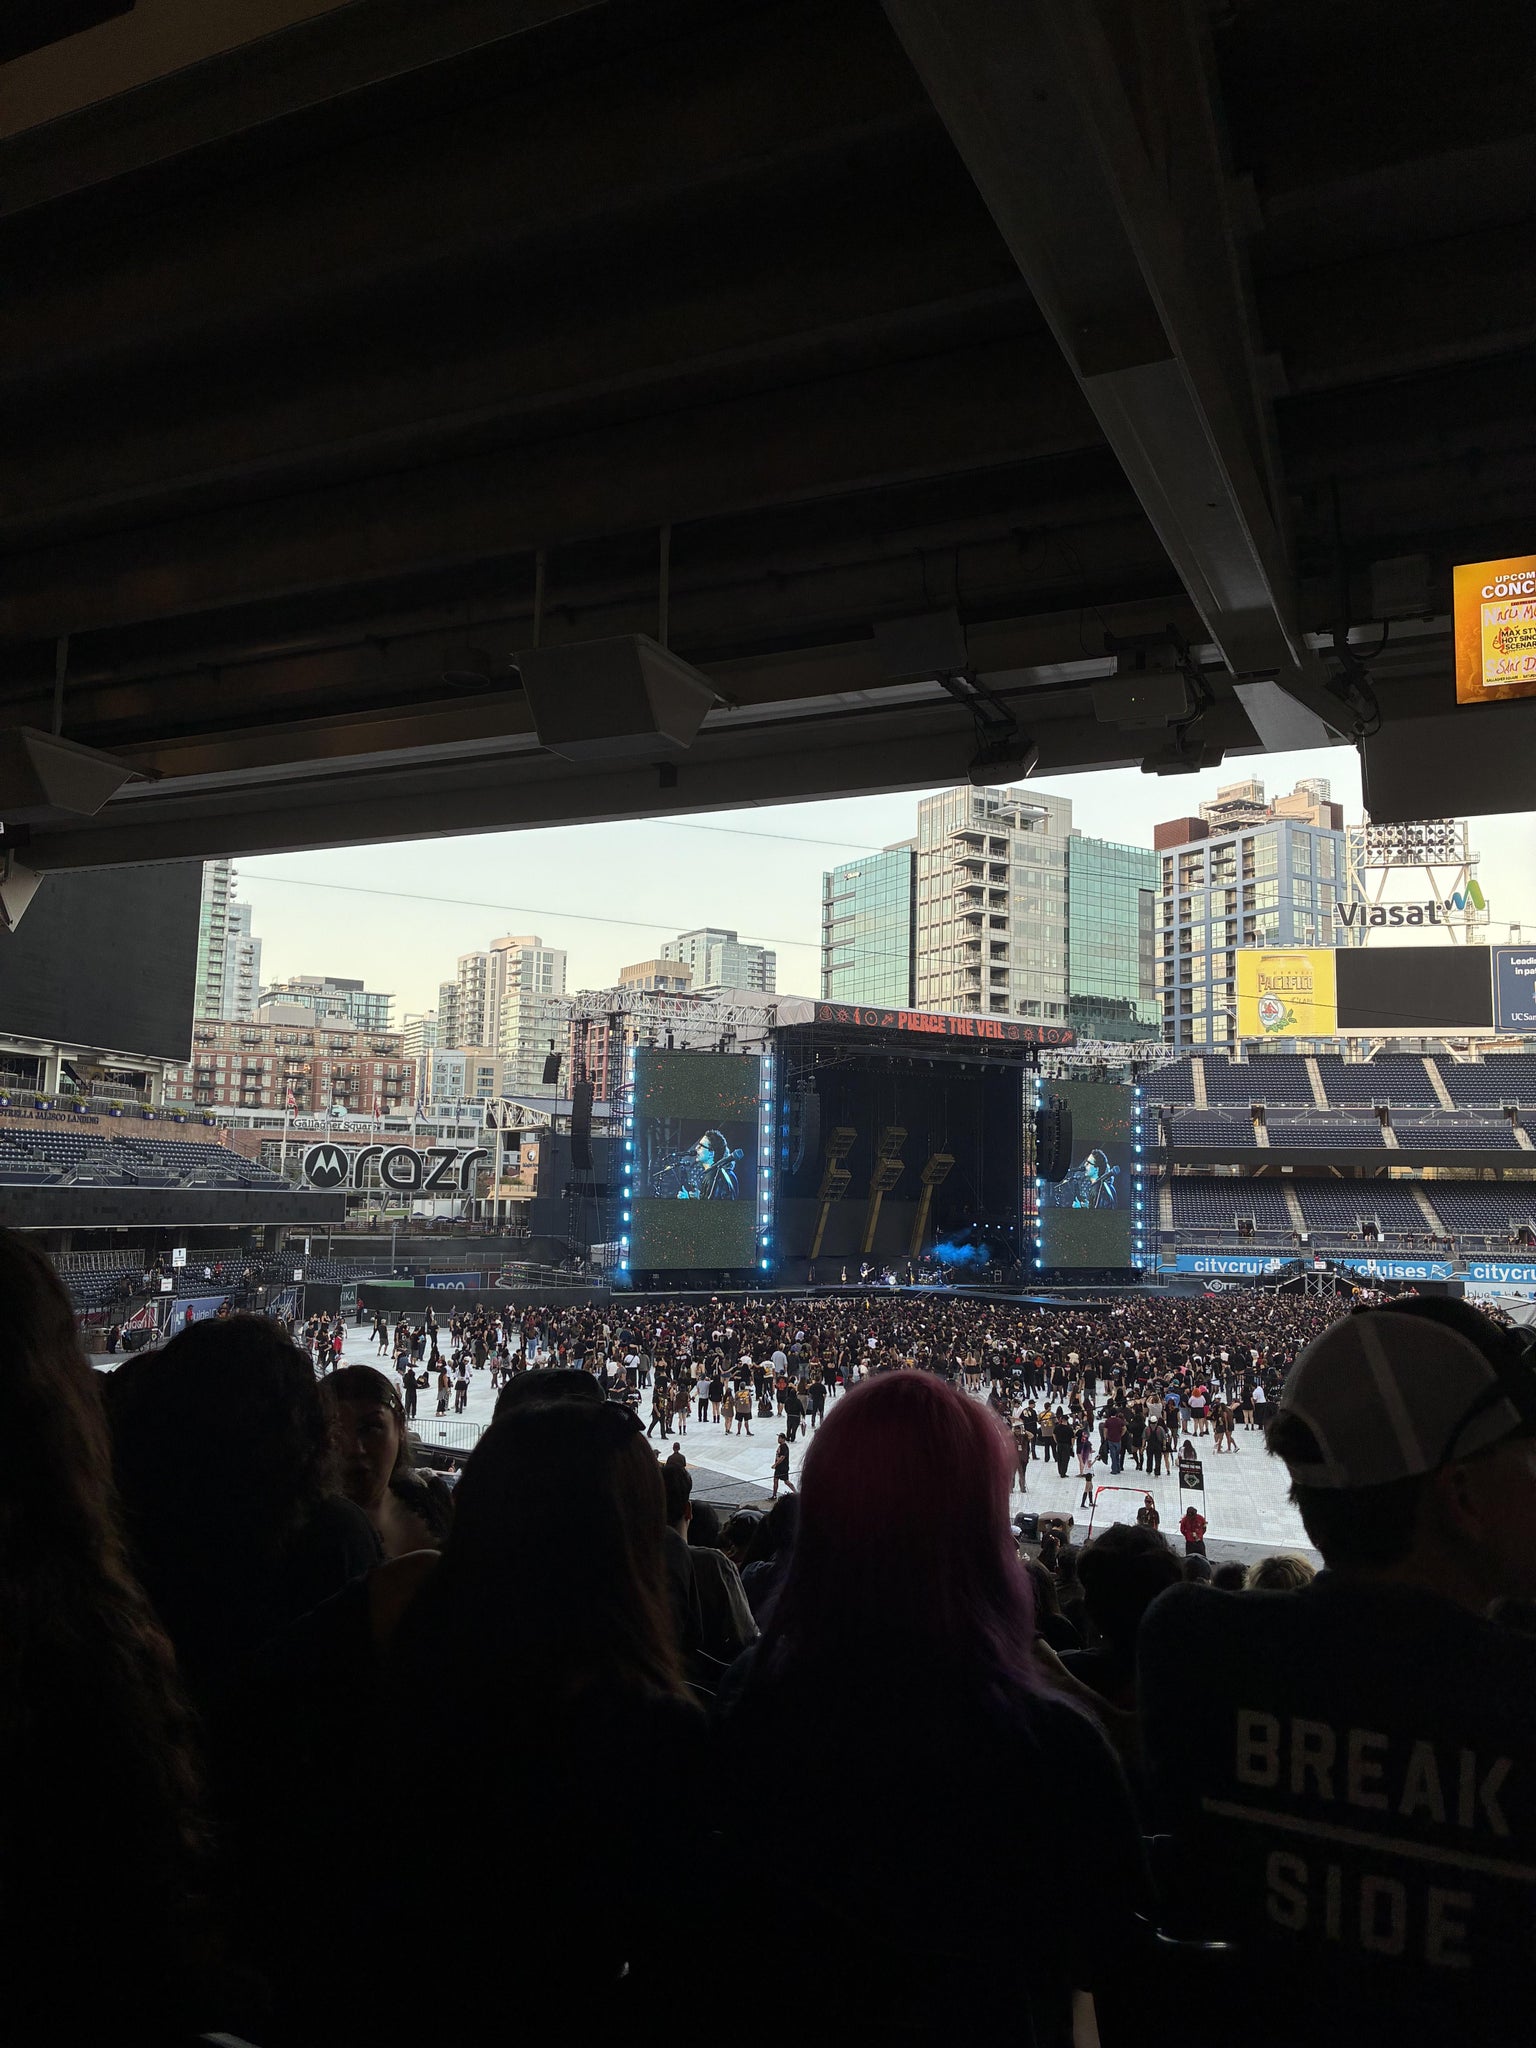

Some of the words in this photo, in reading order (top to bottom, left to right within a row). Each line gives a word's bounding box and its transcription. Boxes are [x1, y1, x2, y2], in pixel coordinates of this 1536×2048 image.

[1495, 571, 1536, 583] UPCOM
[1481, 580, 1536, 599] CONC
[1502, 629, 1521, 637] MAX
[1337, 900, 1441, 926] Viasat
[1515, 967, 1523, 975] in
[1511, 1013, 1523, 1021] UC
[897, 1011, 946, 1034] PIERCE
[948, 1016, 974, 1036] THE
[975, 1019, 1005, 1039] VEIL
[343, 1121, 378, 1132] Square
[353, 1144, 489, 1191] razr
[1467, 1290, 1490, 1298] blue
[1235, 1706, 1513, 1838] BREAK
[1265, 1849, 1474, 1968] SIDE
